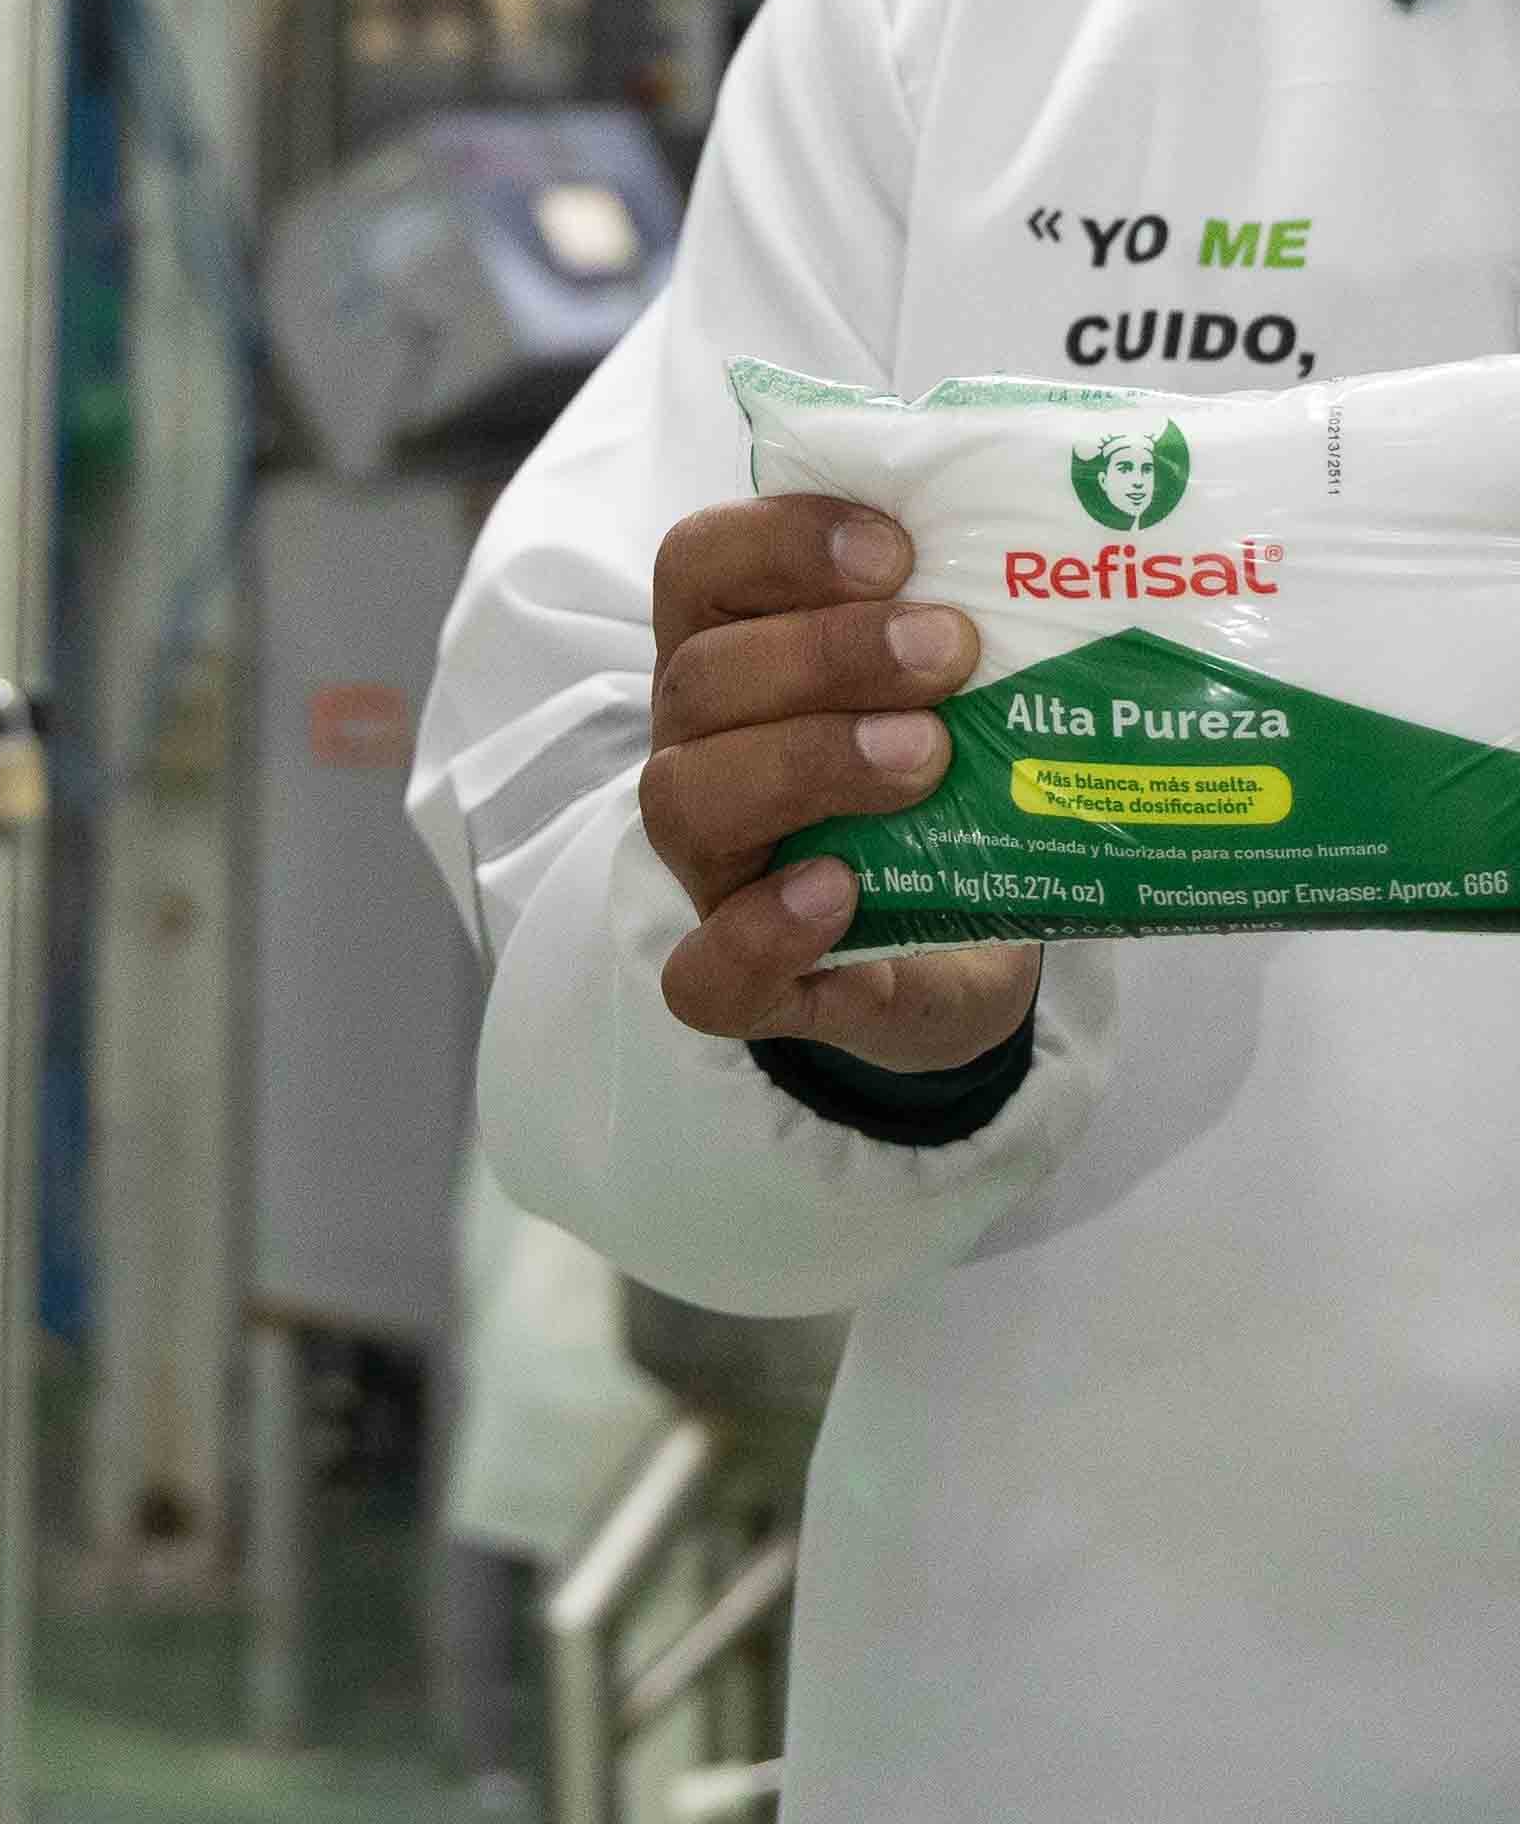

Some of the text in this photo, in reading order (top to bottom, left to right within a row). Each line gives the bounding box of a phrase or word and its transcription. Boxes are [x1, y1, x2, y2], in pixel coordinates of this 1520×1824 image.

[1198, 218, 1313, 269] ME
[1065, 309, 1316, 379] CUIDO,
[1006, 692, 1291, 740] Alta Pureza
[1036, 770, 1264, 794] Más blanca, más suelta.
[1044, 791, 1125, 814] Perfecta
[1027, 837, 1086, 855] yodada
[1089, 845, 1100, 859] y
[1103, 843, 1186, 861] fluorizada
[1191, 848, 1231, 863] para
[1233, 845, 1313, 861] consumo
[1317, 841, 1389, 858] humano
[883, 866, 934, 894] Neto
[1071, 879, 1105, 905] oz)
[1137, 869, 1510, 909] Porciones por Envase: Aprox. 666
